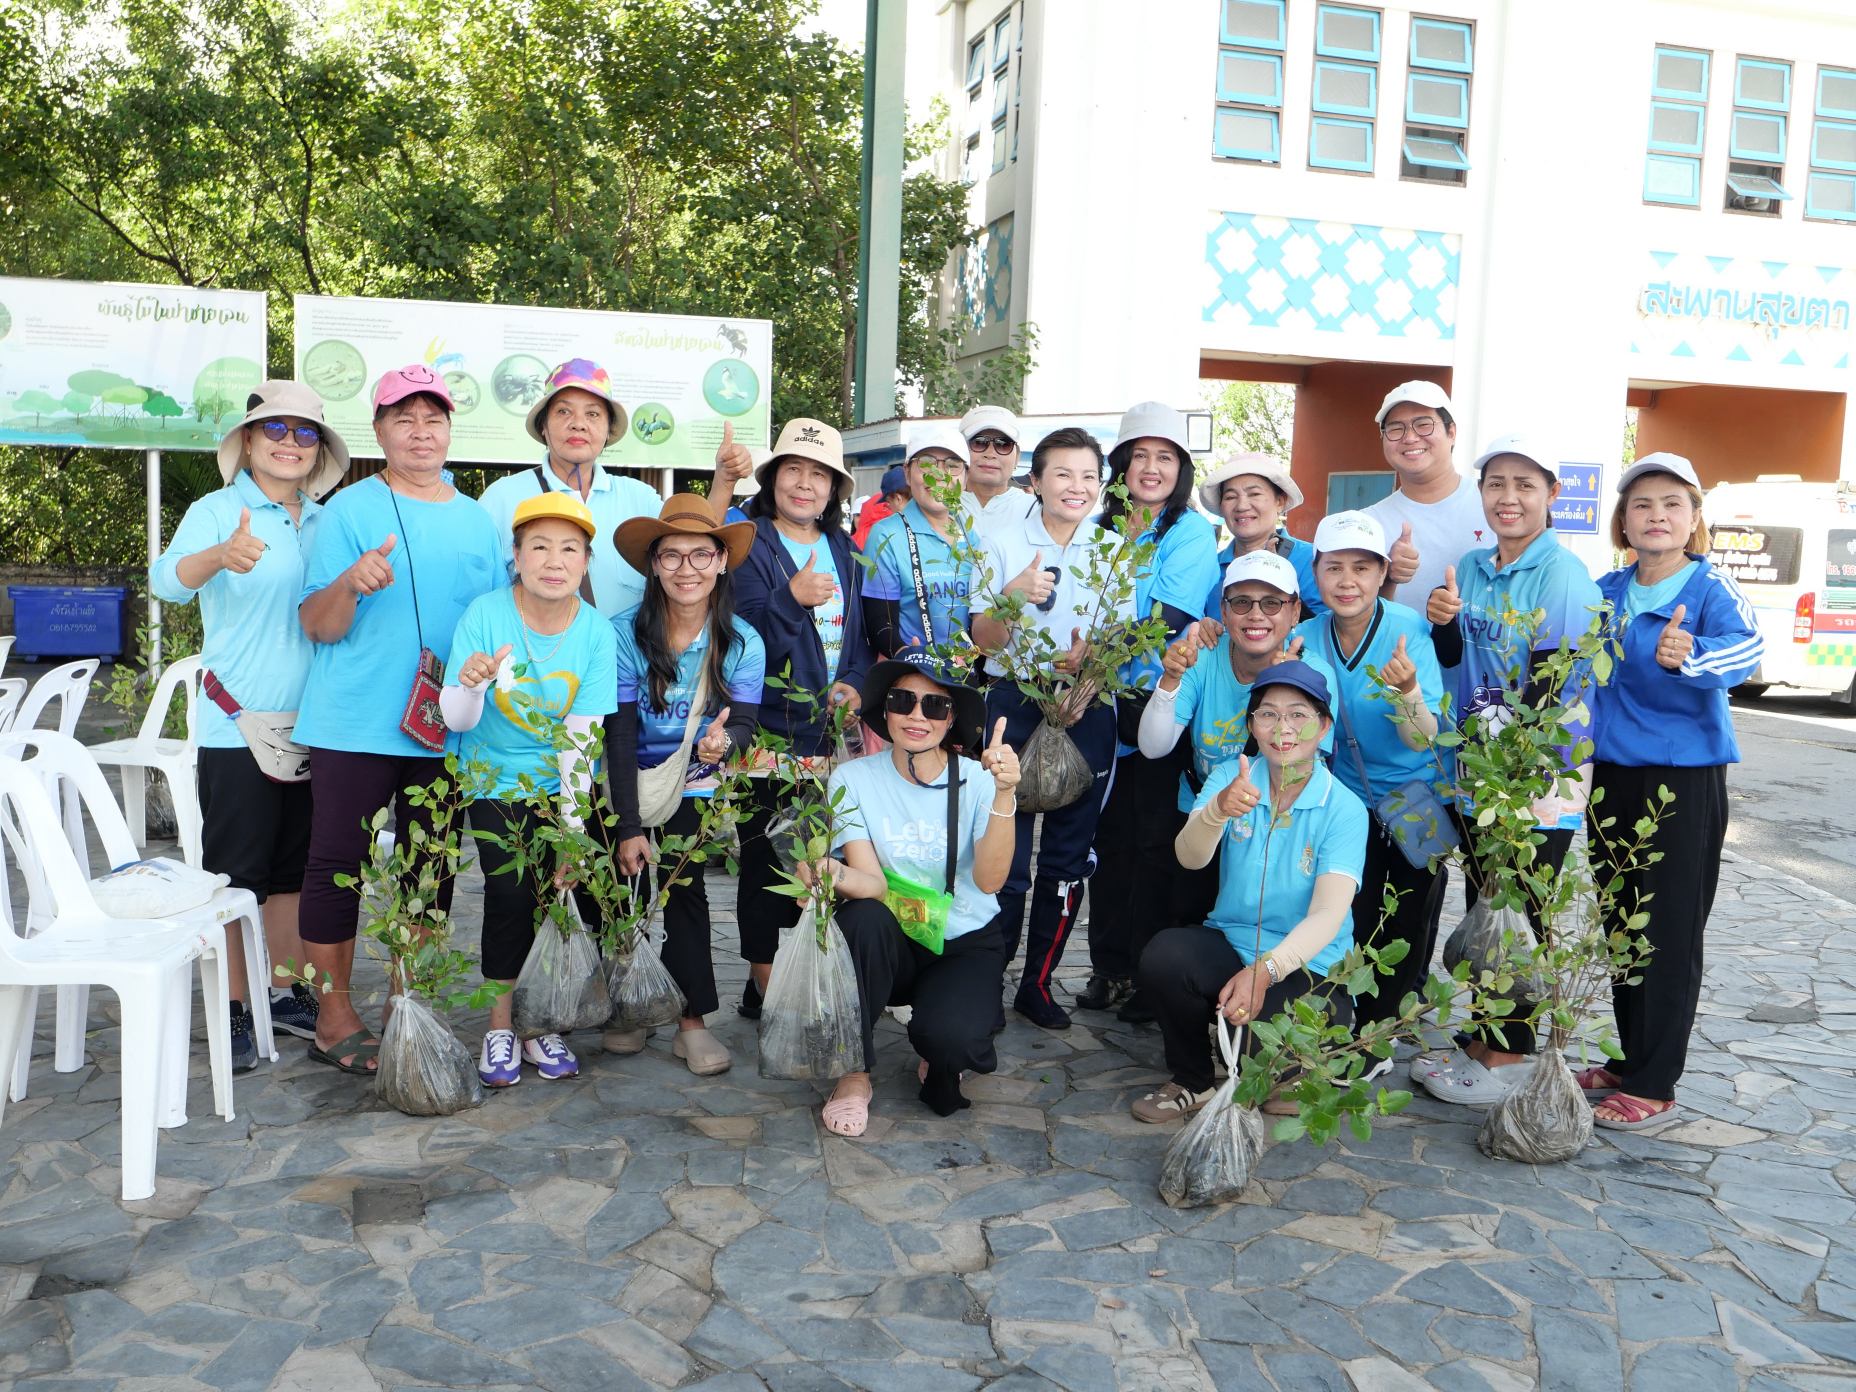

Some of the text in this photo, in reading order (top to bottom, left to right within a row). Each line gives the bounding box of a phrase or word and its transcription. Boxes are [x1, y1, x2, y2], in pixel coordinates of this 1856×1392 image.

[1645, 281, 1850, 340] สะพานสุขตา
[794, 436, 825, 447] adidas
[906, 526, 917, 554] adidas
[1713, 532, 1765, 552] EMS
[912, 567, 925, 598] adidas
[921, 612, 933, 643] adidas
